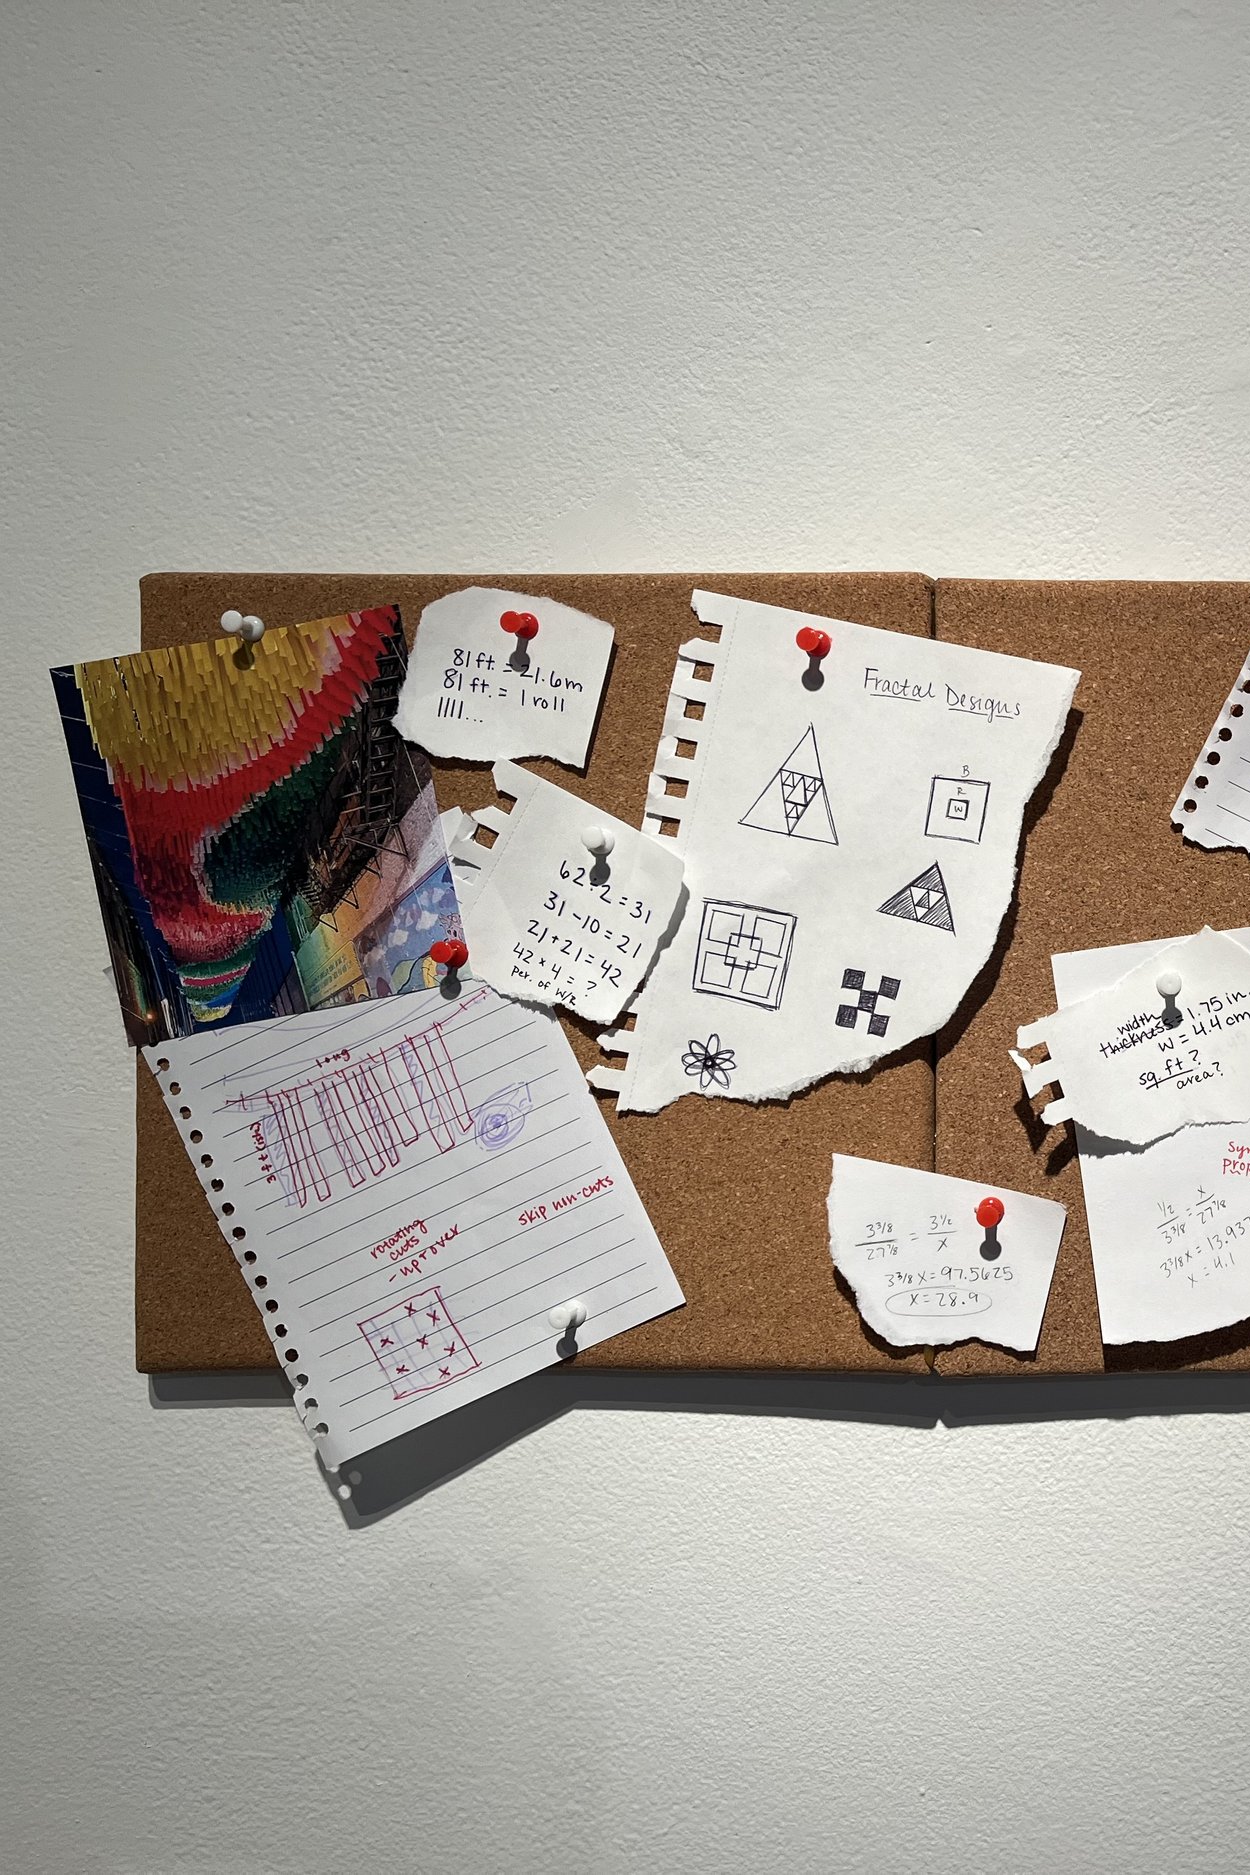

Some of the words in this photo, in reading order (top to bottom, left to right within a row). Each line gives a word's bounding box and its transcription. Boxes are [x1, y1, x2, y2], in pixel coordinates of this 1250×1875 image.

[453, 649, 470, 668] 81
[443, 668, 463, 691] 81
[533, 696, 565, 712] roll
[864, 668, 935, 699] Fractal
[945, 684, 1021, 722] Designs
[560, 861, 585, 886] 62
[599, 884, 612, 904] 2
[629, 901, 652, 924] 31
[543, 890, 566, 917] 31
[617, 935, 642, 958] 21
[550, 963, 562, 980] 4
[1187, 996, 1224, 1020] 1.75
[1117, 1011, 1162, 1036] width
[1192, 1016, 1223, 1038] 4.4
[316, 1049, 351, 1068] long
[1176, 1061, 1225, 1090] area?
[517, 1204, 549, 1226] skip
[370, 1218, 428, 1260] rotating
[389, 1235, 421, 1261] cuts
